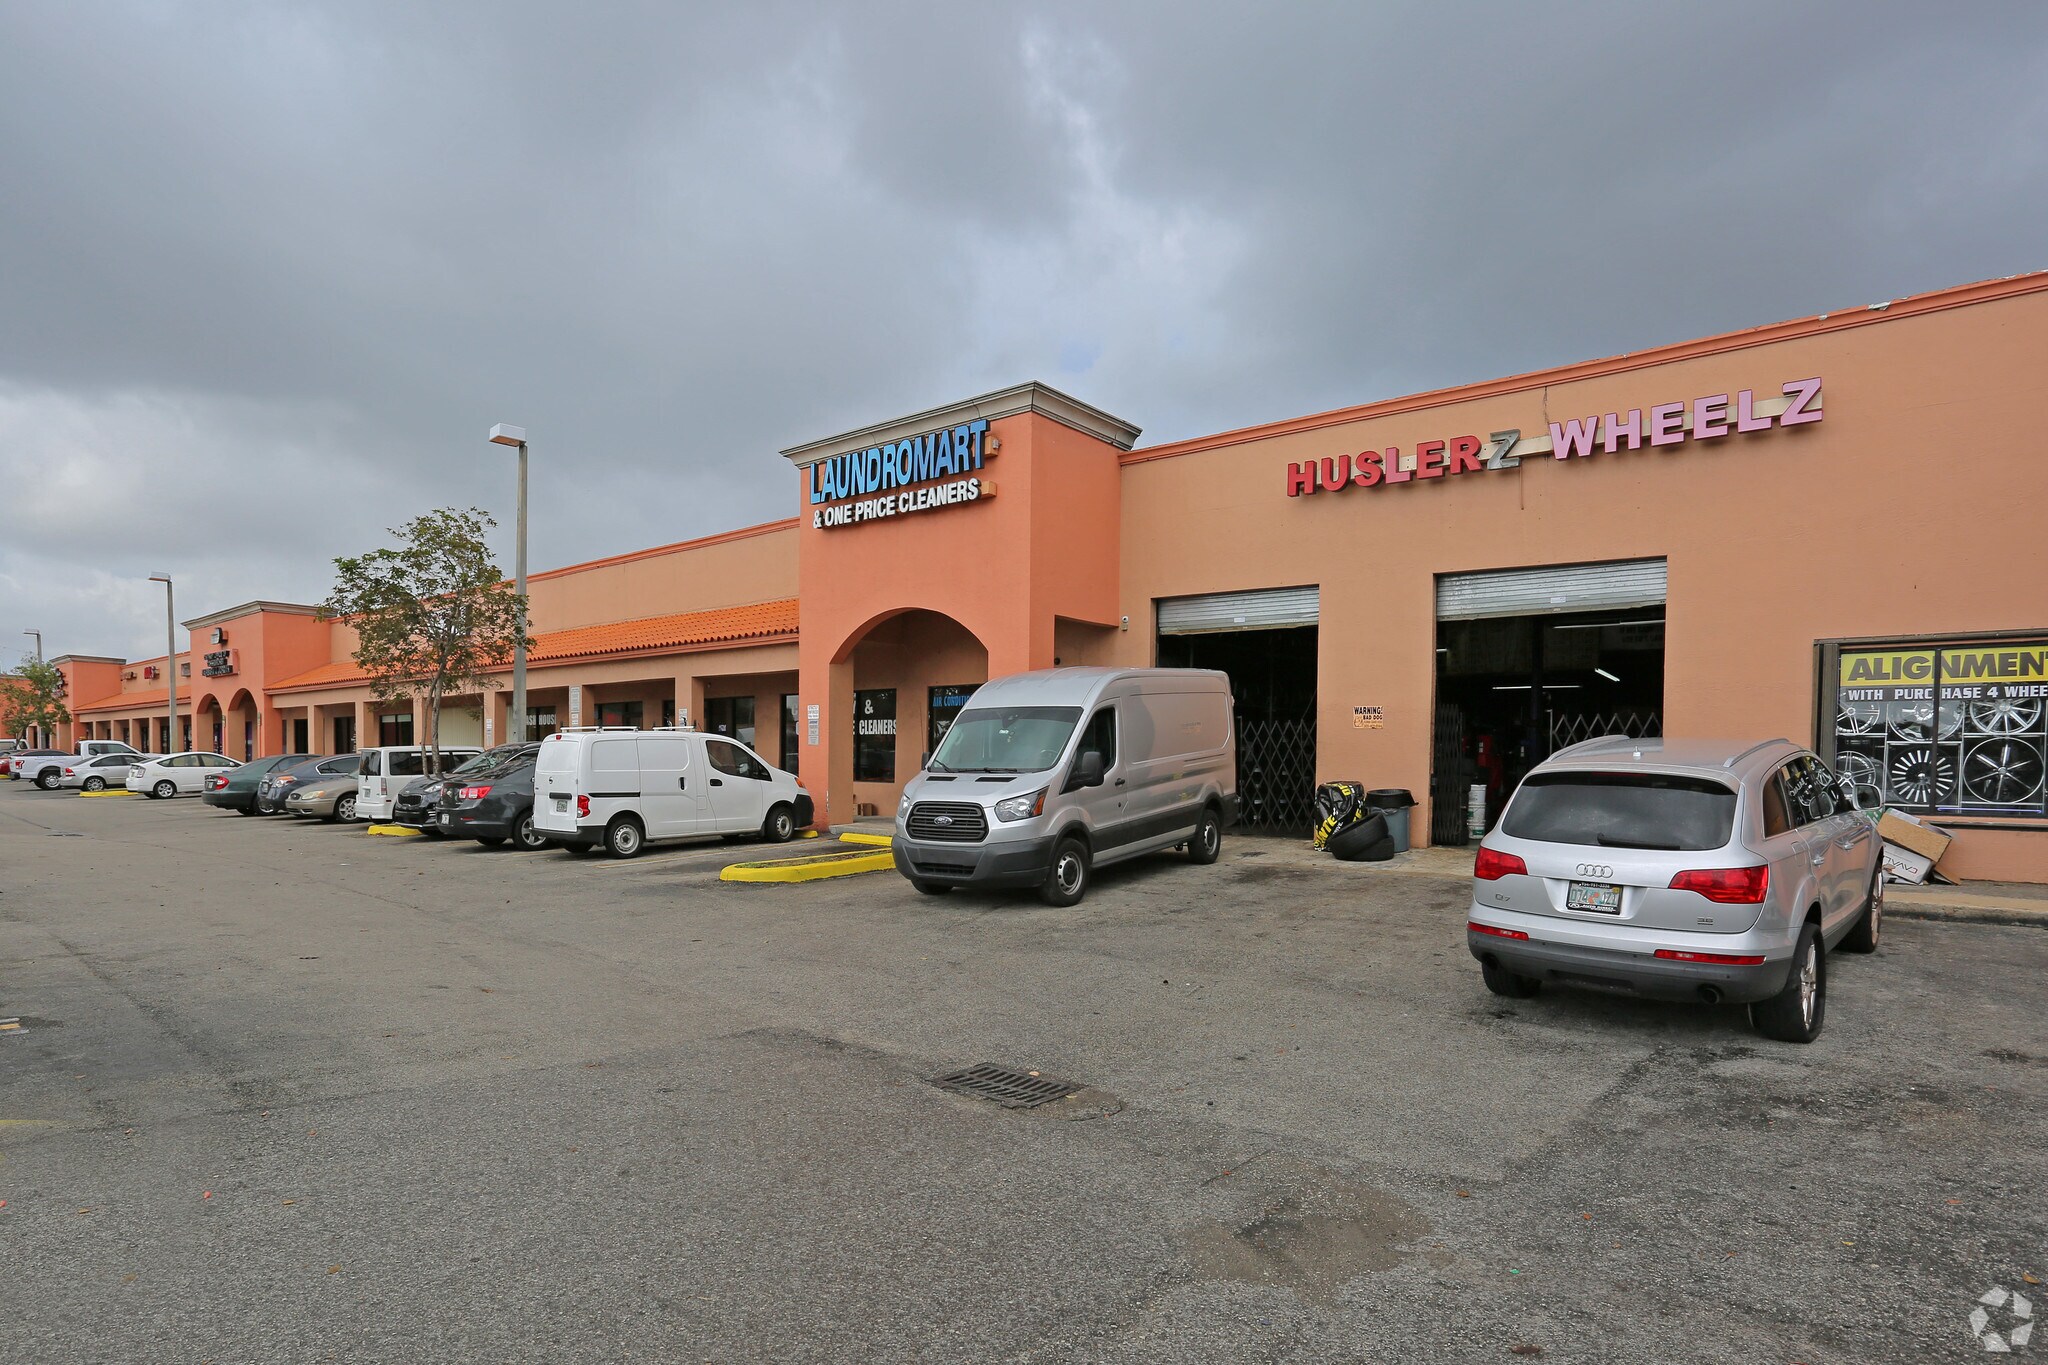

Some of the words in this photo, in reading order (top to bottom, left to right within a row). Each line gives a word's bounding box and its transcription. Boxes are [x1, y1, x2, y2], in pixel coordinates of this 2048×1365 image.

[1287, 428, 1521, 497] HUSLERZ
[1549, 377, 1823, 460] WHEELZ
[810, 419, 989, 505] LAUNDROMART
[812, 509, 823, 529] &
[824, 503, 852, 527] ONE
[855, 494, 896, 522] PRICE
[898, 477, 980, 513] CLEANERS
[1847, 651, 2048, 681] ALIGNMEN
[933, 695, 943, 707] AIR
[1847, 689, 1884, 701] WITH
[1986, 686, 1999, 698] 4
[864, 699, 874, 715] &
[538, 713, 556, 726] HOUS
[858, 719, 897, 735] CLEANERS
